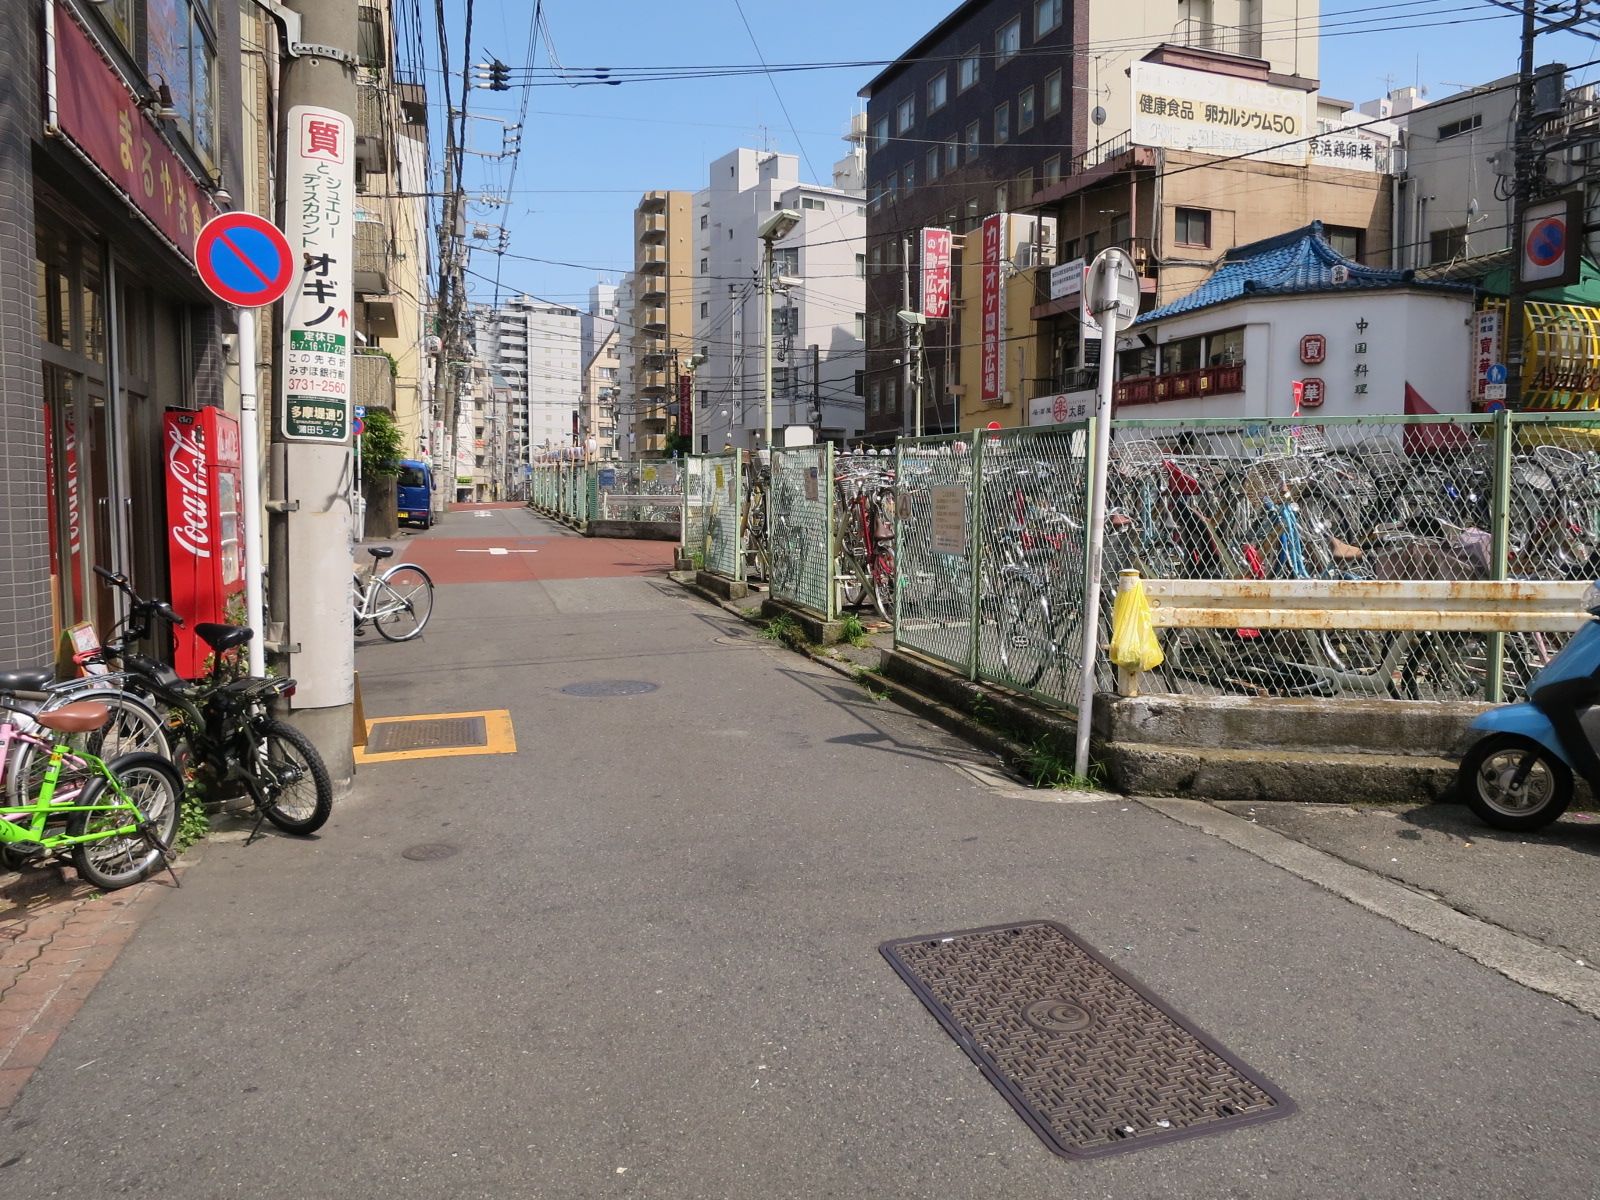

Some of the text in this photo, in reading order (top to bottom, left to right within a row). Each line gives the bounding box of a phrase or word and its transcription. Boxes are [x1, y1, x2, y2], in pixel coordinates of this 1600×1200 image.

[307, 120, 340, 158] 質
[119, 109, 213, 246] まるやま食
[302, 173, 322, 248] ディスカウント
[325, 177, 342, 239] ジュエリー
[303, 252, 338, 327] オギノ
[926, 238, 938, 315] の歌広場
[937, 234, 949, 315] カラオケ
[289, 354, 346, 368] この先右折
[303, 332, 336, 343] 定休日
[1353, 316, 1369, 395] 中国料理
[288, 379, 346, 394] 3731-2560
[289, 366, 345, 380] みずほ銀行前
[291, 406, 344, 421] 多摩堤通り
[169, 421, 210, 558] Coca-Cola
